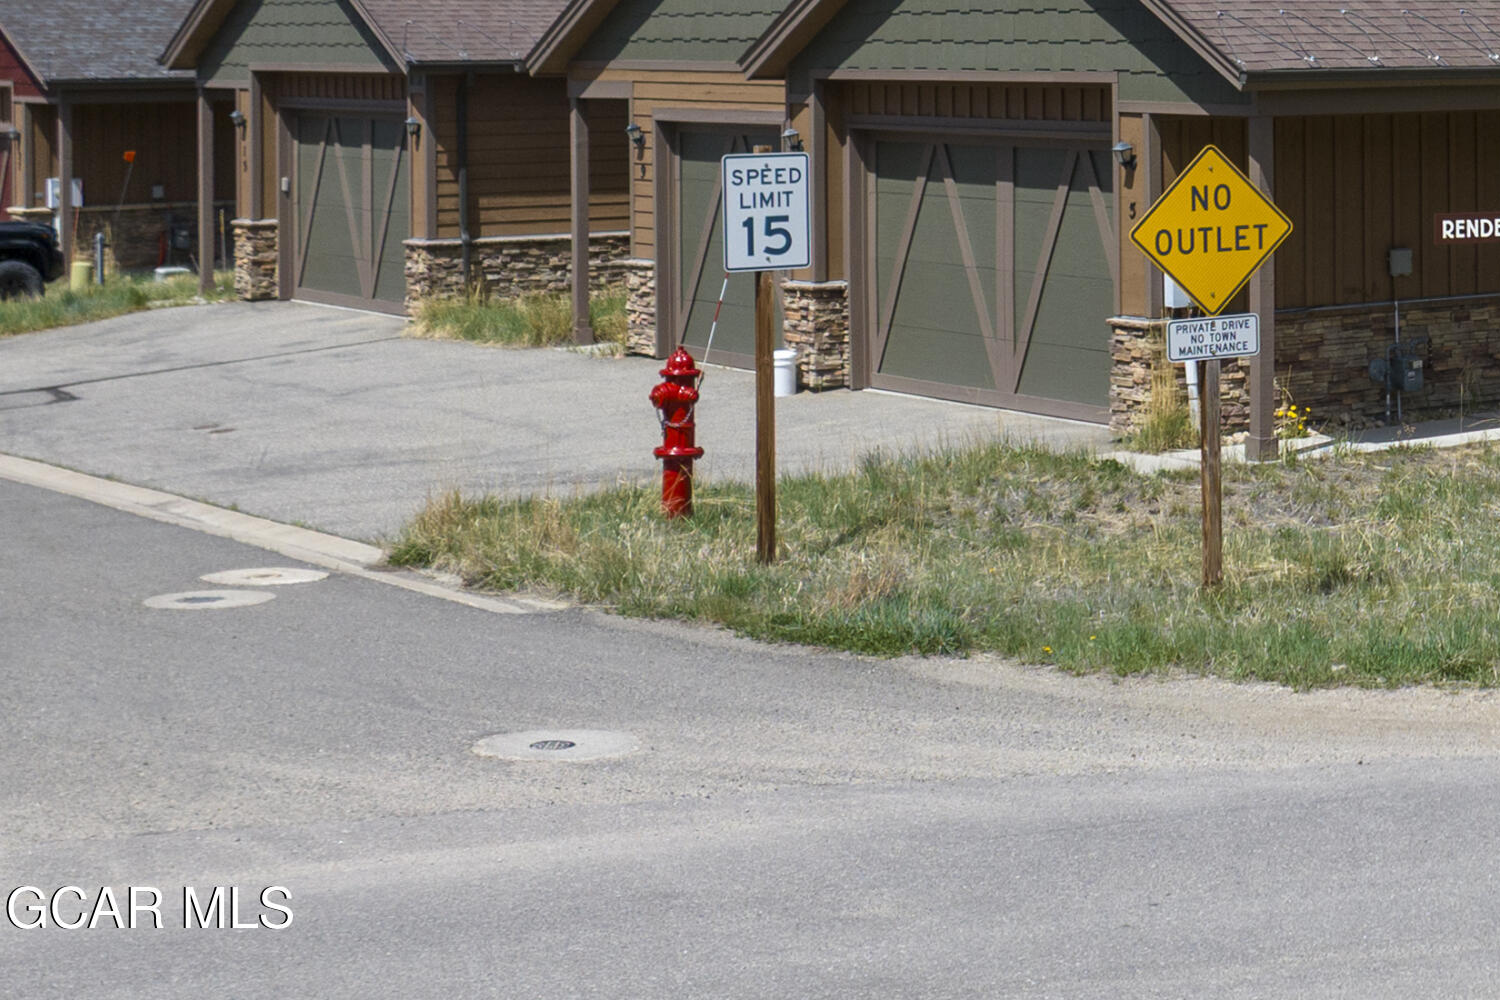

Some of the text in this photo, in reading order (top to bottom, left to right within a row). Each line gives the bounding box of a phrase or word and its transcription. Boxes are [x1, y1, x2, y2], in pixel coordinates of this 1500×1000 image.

[731, 166, 802, 186] SPEED
[739, 190, 794, 210] LIMIT
[1191, 184, 1231, 212] NO
[742, 215, 793, 257] 15
[1155, 223, 1269, 257] OUTLET
[1175, 318, 1250, 334] PRIVATE DRIVE
[1190, 331, 1237, 345] NO TOWN
[1178, 340, 1249, 357] MAINTENANCE
